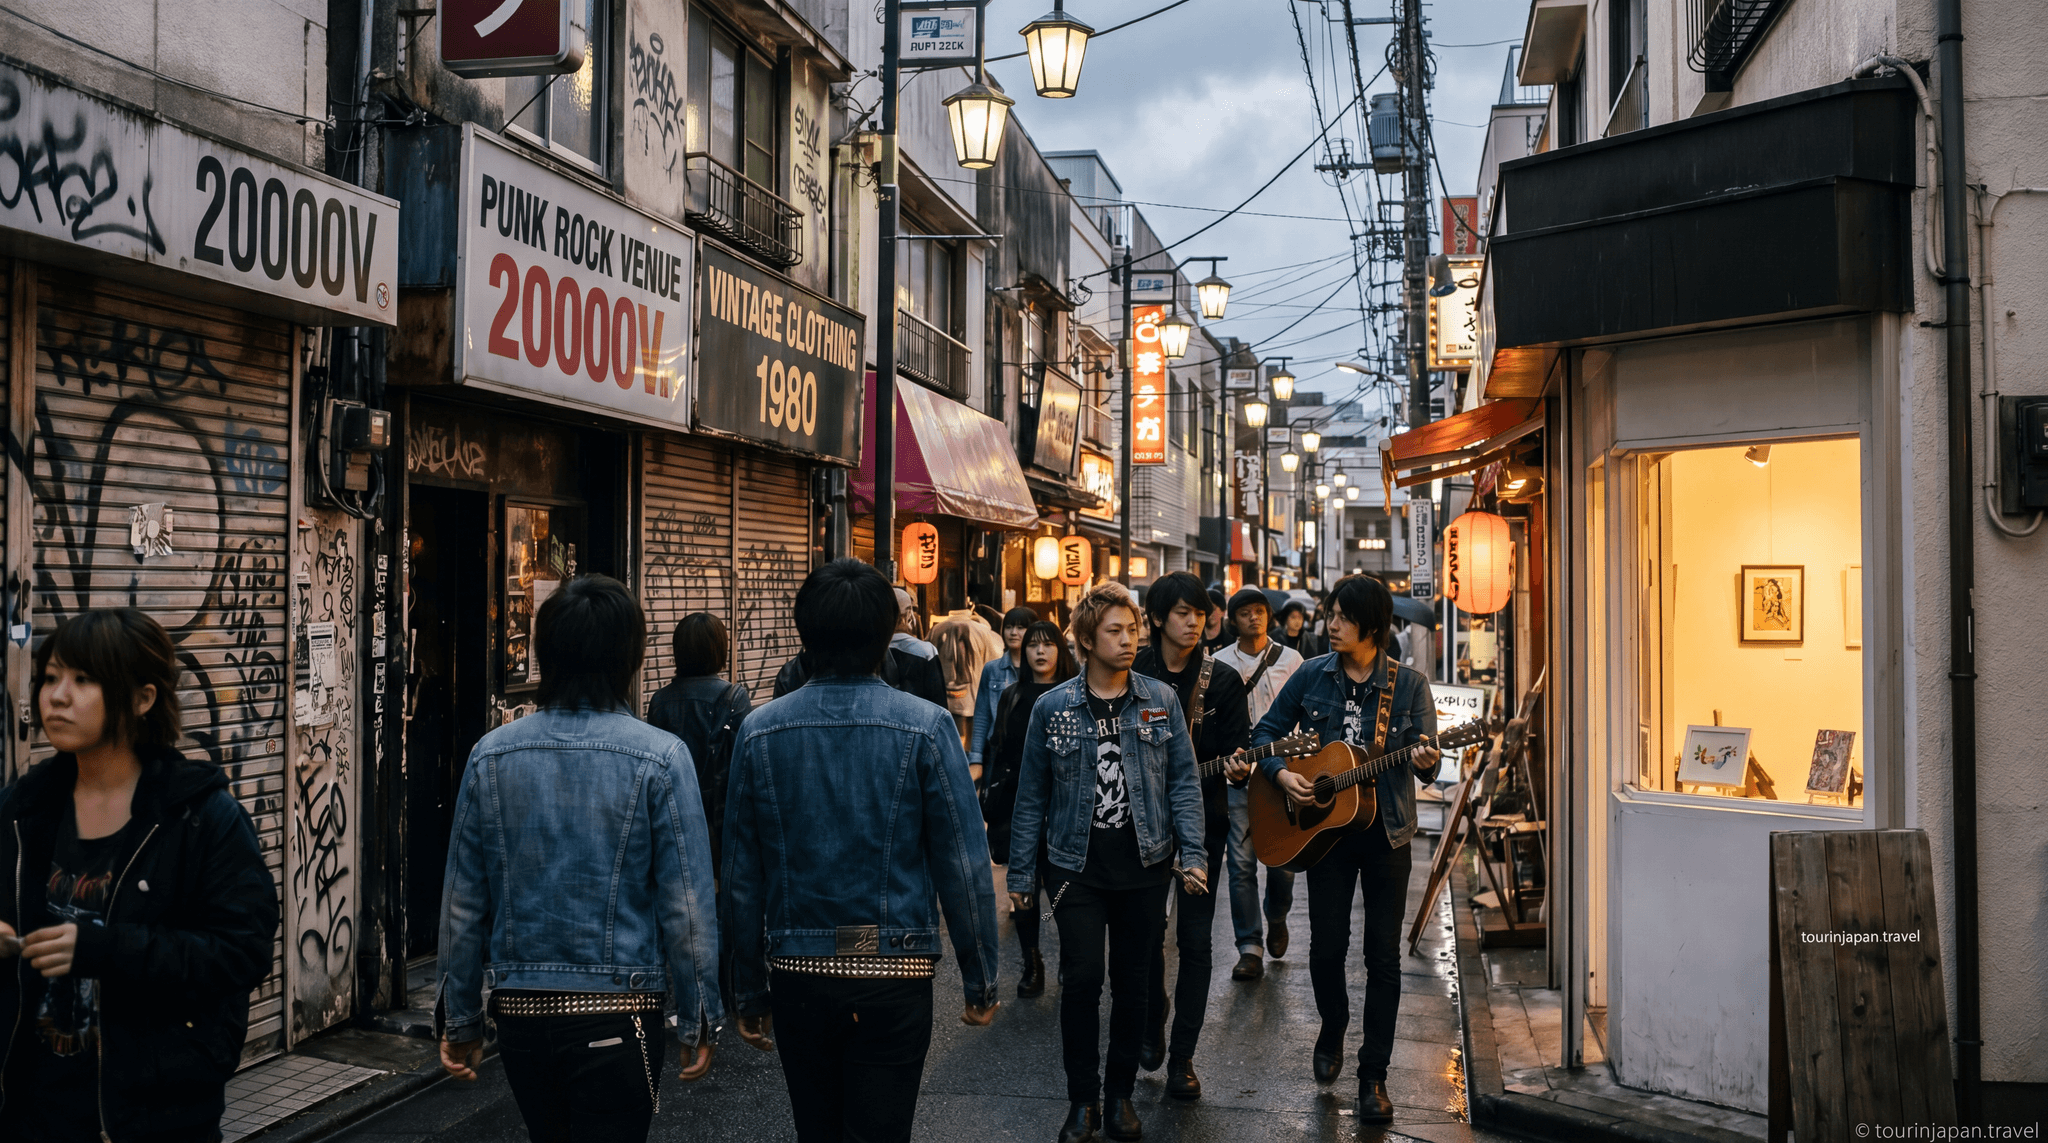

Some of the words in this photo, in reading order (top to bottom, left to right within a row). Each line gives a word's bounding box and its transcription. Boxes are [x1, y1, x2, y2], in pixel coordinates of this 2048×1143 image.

[194, 155, 378, 303] 20000V
[480, 173, 548, 252] PUNK
[554, 205, 614, 278] ROCK
[620, 232, 682, 303] VENUE
[708, 265, 784, 344] VINTAGE
[785, 300, 857, 373] CLOTHING
[756, 353, 818, 437] 1980
